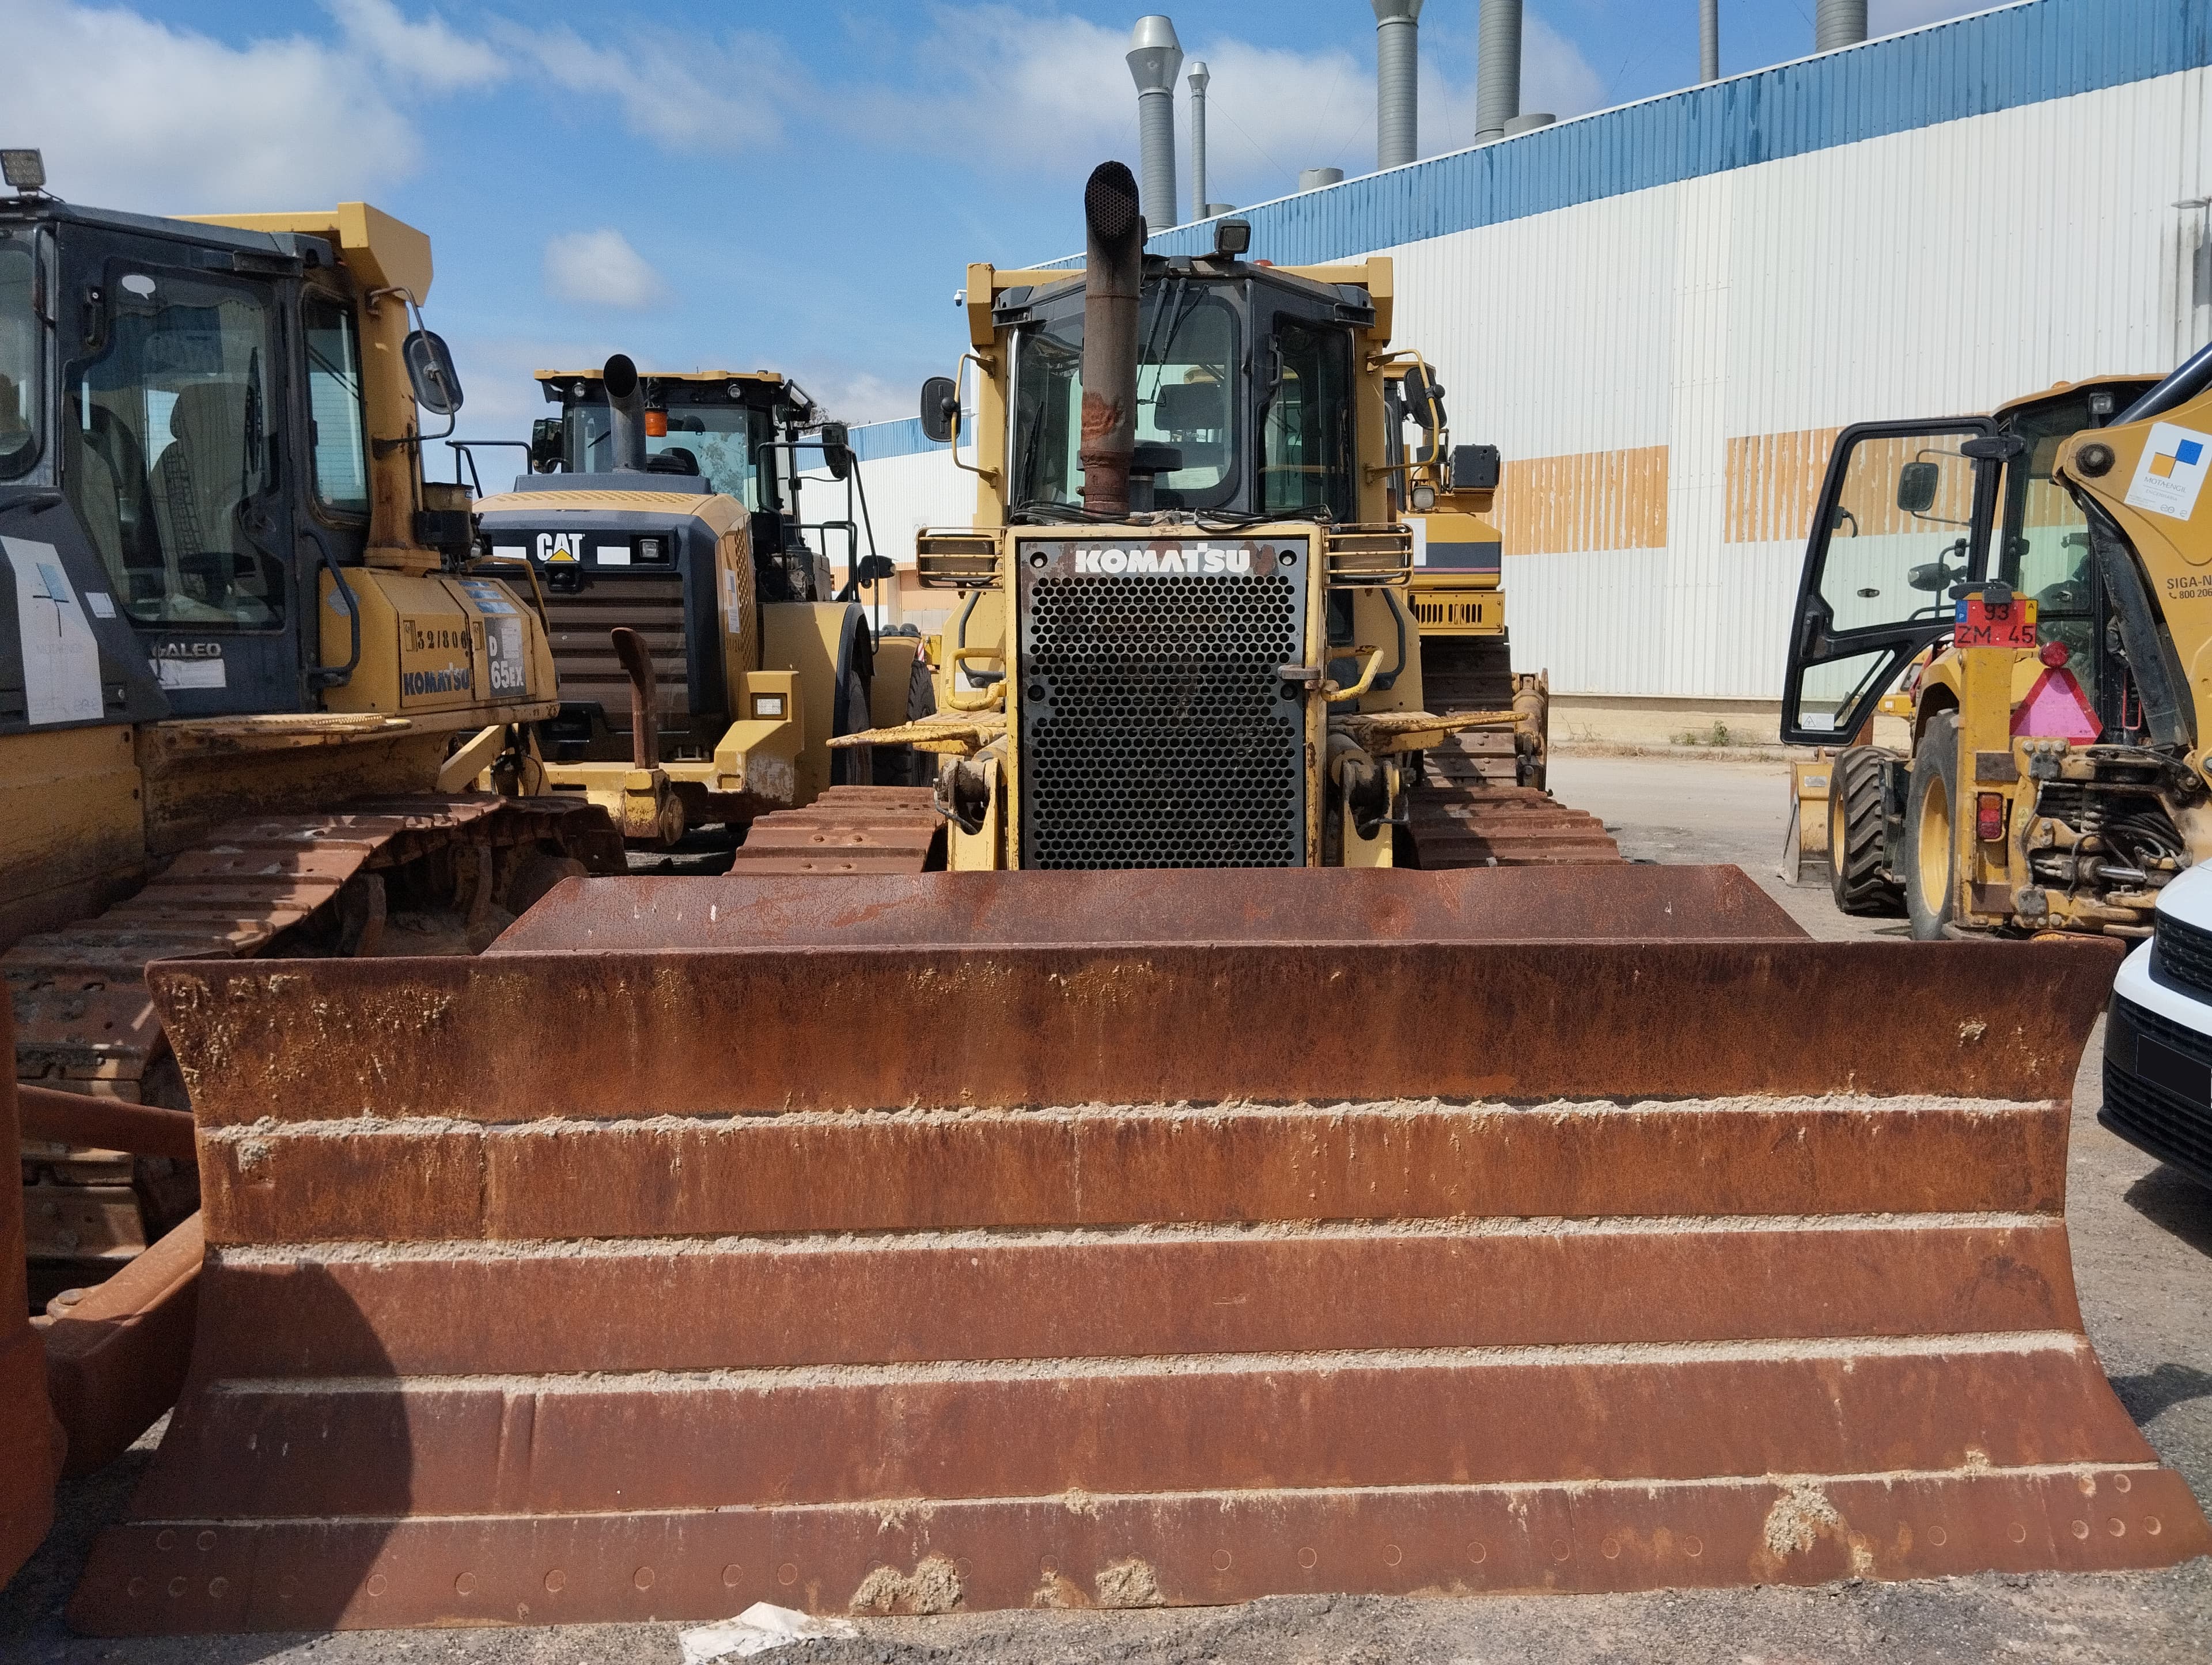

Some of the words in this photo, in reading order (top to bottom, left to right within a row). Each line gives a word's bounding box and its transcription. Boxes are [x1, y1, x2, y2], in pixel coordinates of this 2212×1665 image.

[536, 533, 582, 562] CAT
[1075, 543, 1250, 573] KOMATSU
[2179, 590, 2195, 599] 800
[2197, 588, 2212, 597] 206
[1984, 604, 2009, 620] 93
[1958, 625, 1991, 644] ZM
[2008, 625, 2034, 643] 45
[488, 635, 498, 657] D
[404, 662, 470, 696] KOMATSU
